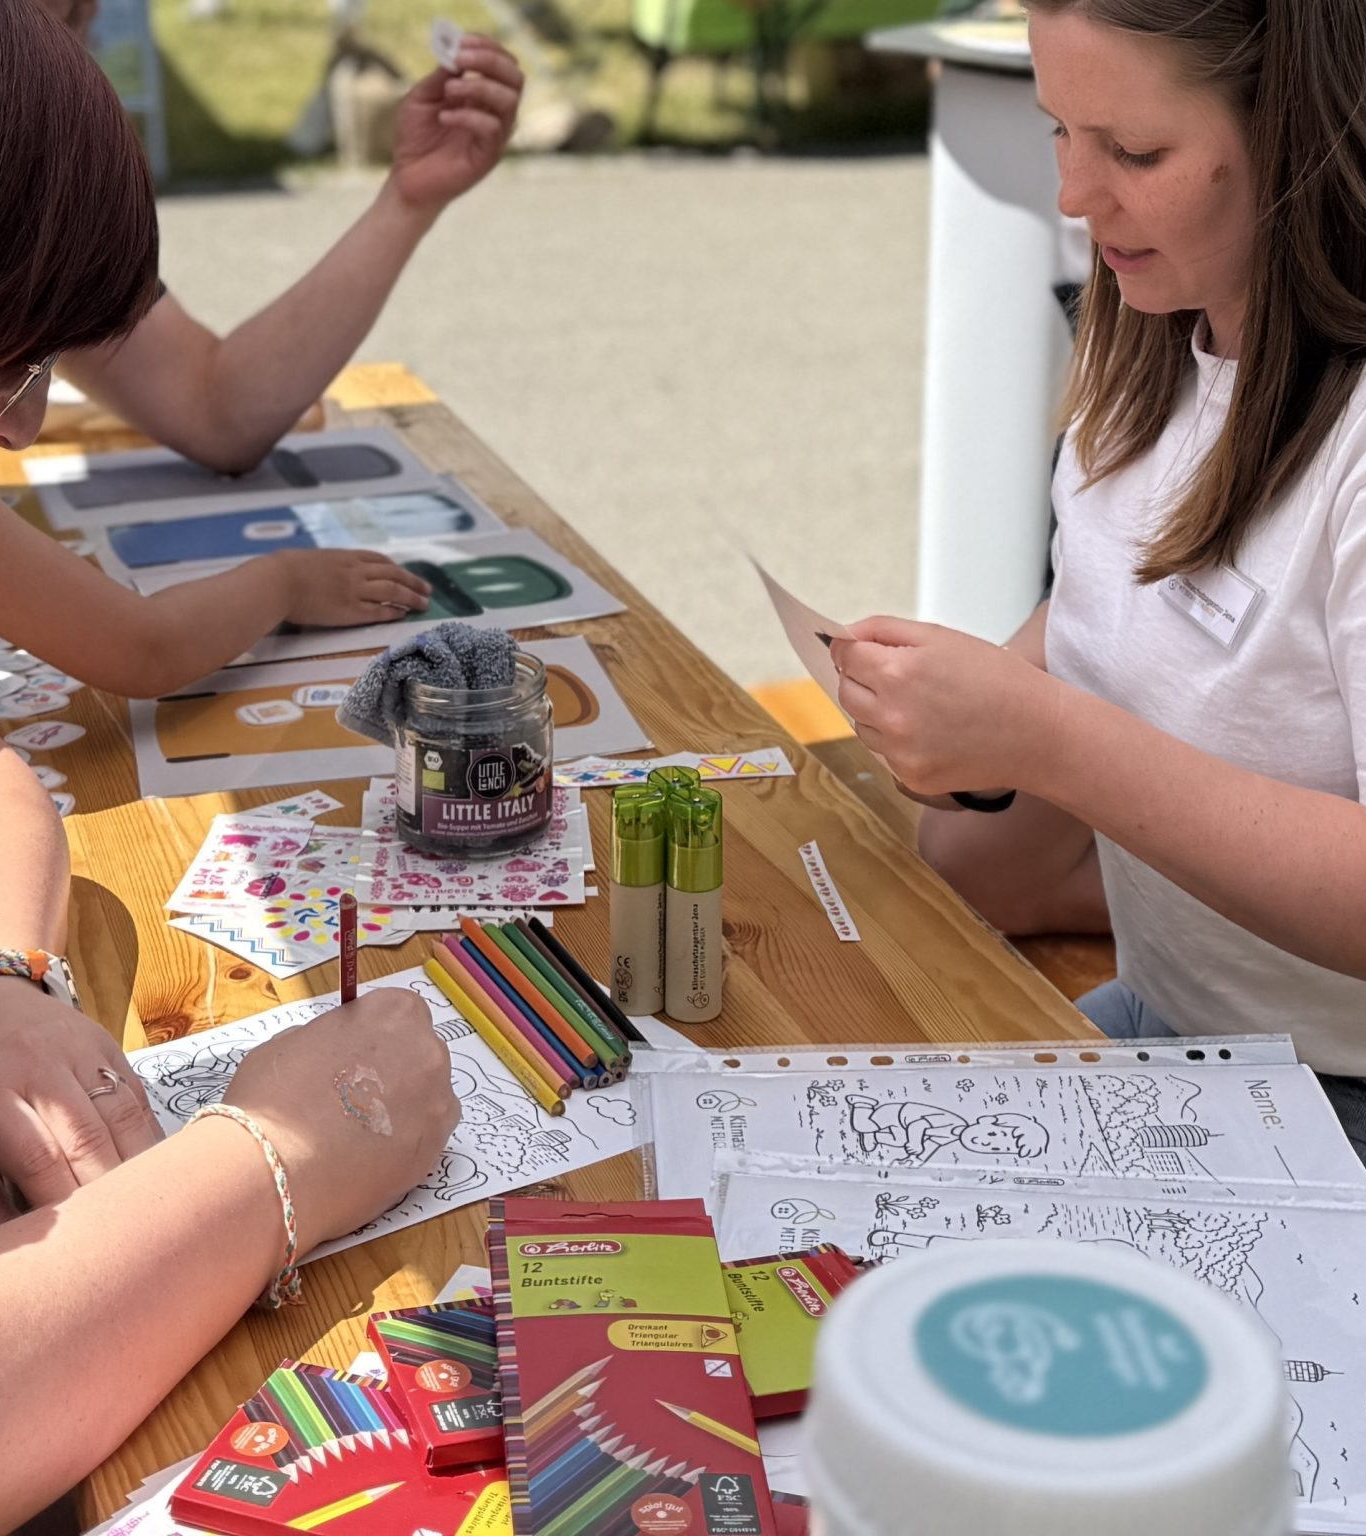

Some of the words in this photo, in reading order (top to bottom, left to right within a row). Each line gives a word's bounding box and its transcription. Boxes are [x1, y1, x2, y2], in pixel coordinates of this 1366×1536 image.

[478, 762, 505, 777] LITTLE
[442, 803, 492, 821] LITTLE
[498, 794, 535, 818] ITALY
[470, 823, 481, 831] mit
[1244, 1079, 1285, 1130] Name:
[710, 1115, 725, 1131] MIT
[780, 1226, 796, 1243] MIT
[521, 1262, 543, 1274] 12
[521, 1275, 603, 1288] Buntstifte
[750, 1270, 770, 1281] 12
[727, 1273, 765, 1312] Buntstifte
[628, 1323, 668, 1331] Dreikant
[629, 1331, 679, 1340] Triangular
[631, 1339, 693, 1349] Triangulaires
[638, 1501, 663, 1514] spiel
[665, 1503, 684, 1513] gut
